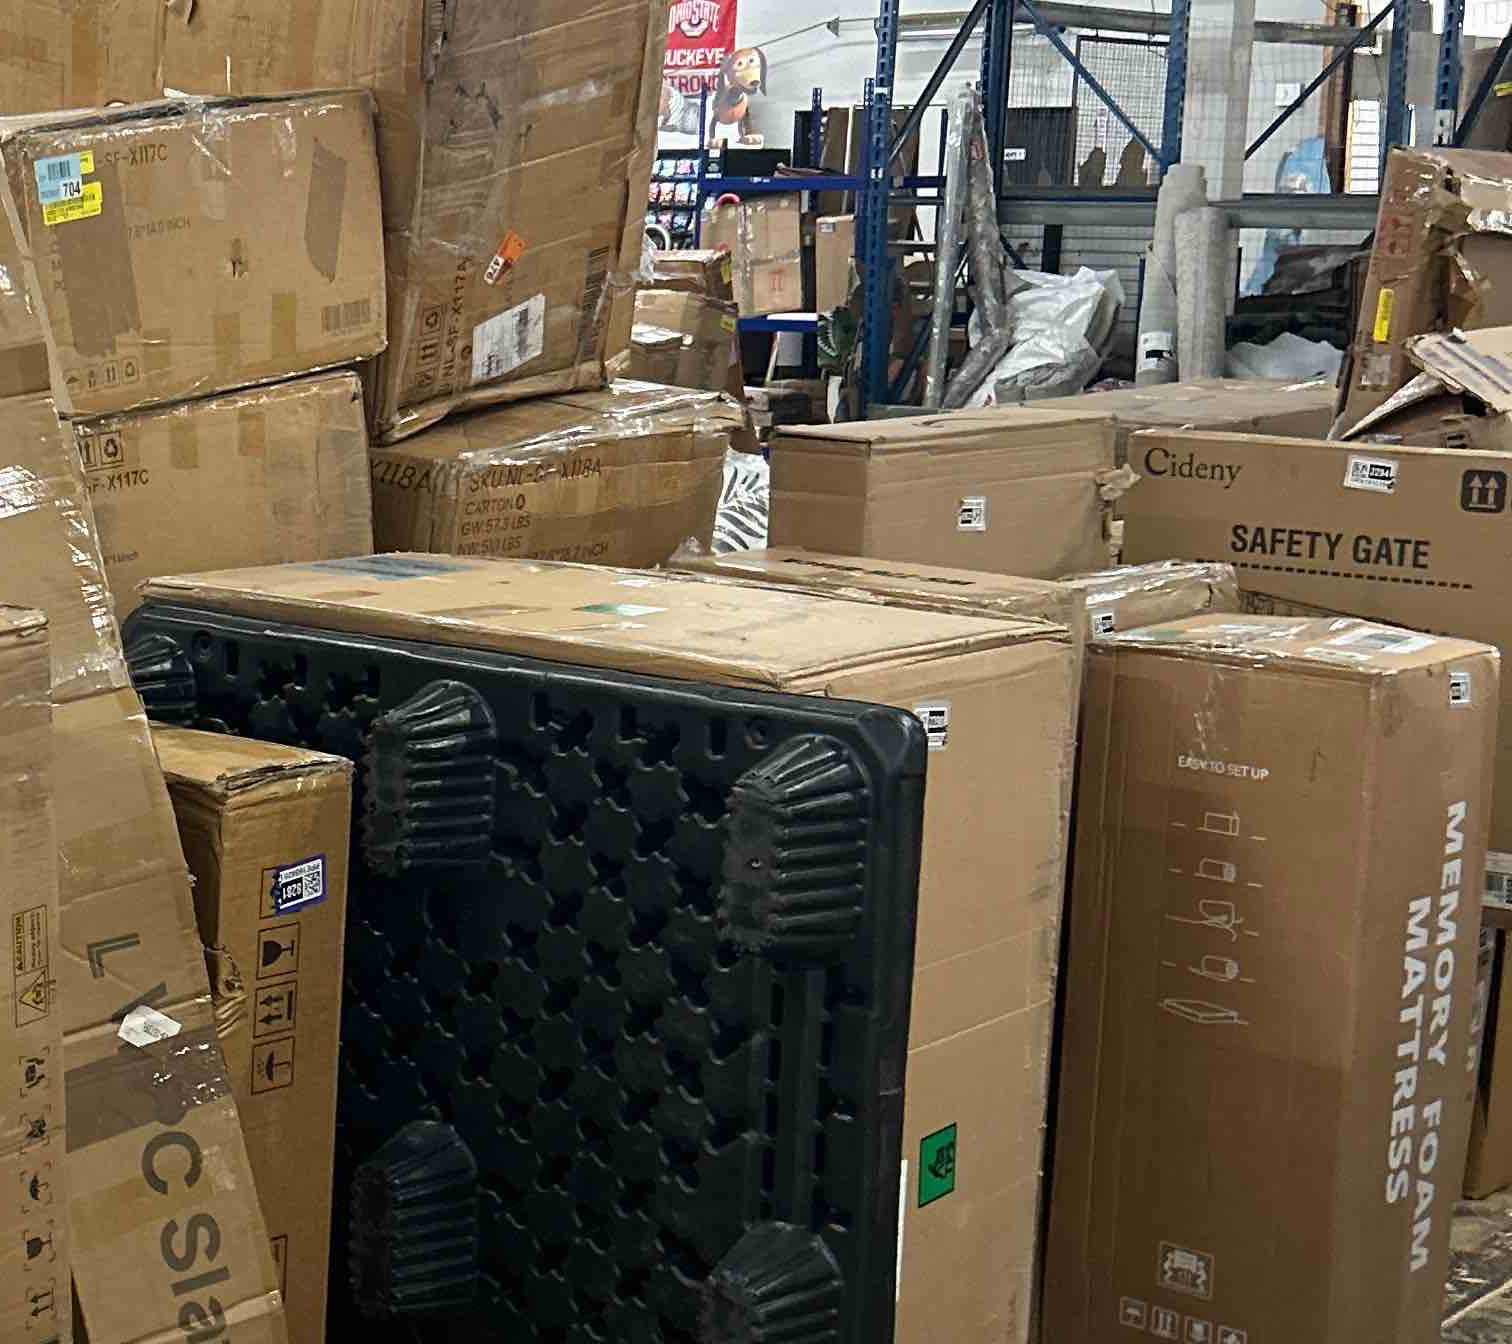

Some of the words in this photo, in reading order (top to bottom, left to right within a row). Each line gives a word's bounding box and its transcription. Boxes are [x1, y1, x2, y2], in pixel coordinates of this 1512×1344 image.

[62, 180, 82, 198] 704
[1143, 447, 1242, 489] Cideny
[1230, 523, 1344, 562] SAFETY
[1352, 535, 1431, 571] GATE
[1250, 767, 1270, 781] UP
[1427, 800, 1467, 1066] MEMORY
[1386, 895, 1432, 1205] MATTRESS
[1409, 1098, 1443, 1273] FOAM
